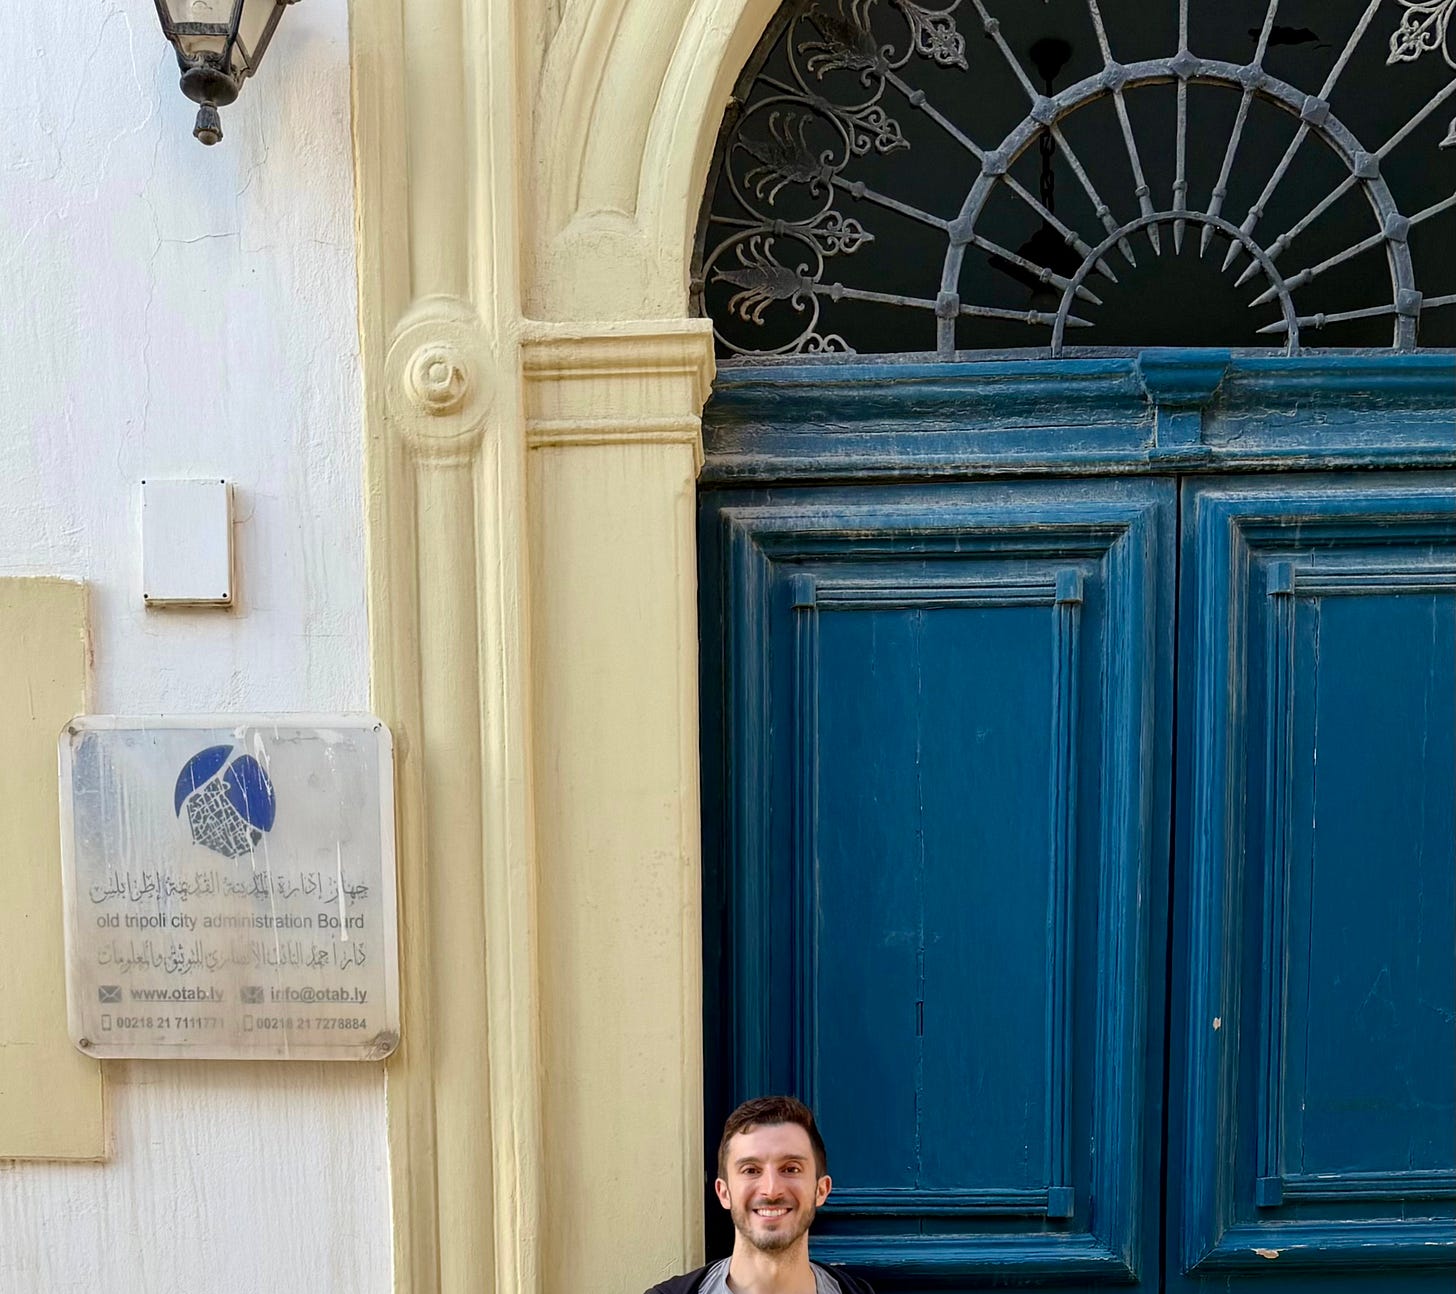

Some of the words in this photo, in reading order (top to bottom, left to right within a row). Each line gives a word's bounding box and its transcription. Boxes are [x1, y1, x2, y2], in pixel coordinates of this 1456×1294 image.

[96, 912, 120, 928] old
[125, 912, 166, 931] tripoli
[171, 912, 197, 931] city
[203, 912, 312, 928] administration
[130, 986, 225, 1003] www.otab.ly
[271, 986, 368, 1004] info@otab.ly
[116, 1016, 154, 1029] 00218
[156, 1016, 171, 1029] 21
[256, 1017, 294, 1030] 00218
[297, 1017, 311, 1030] 21
[315, 1017, 367, 1030] 7278884
